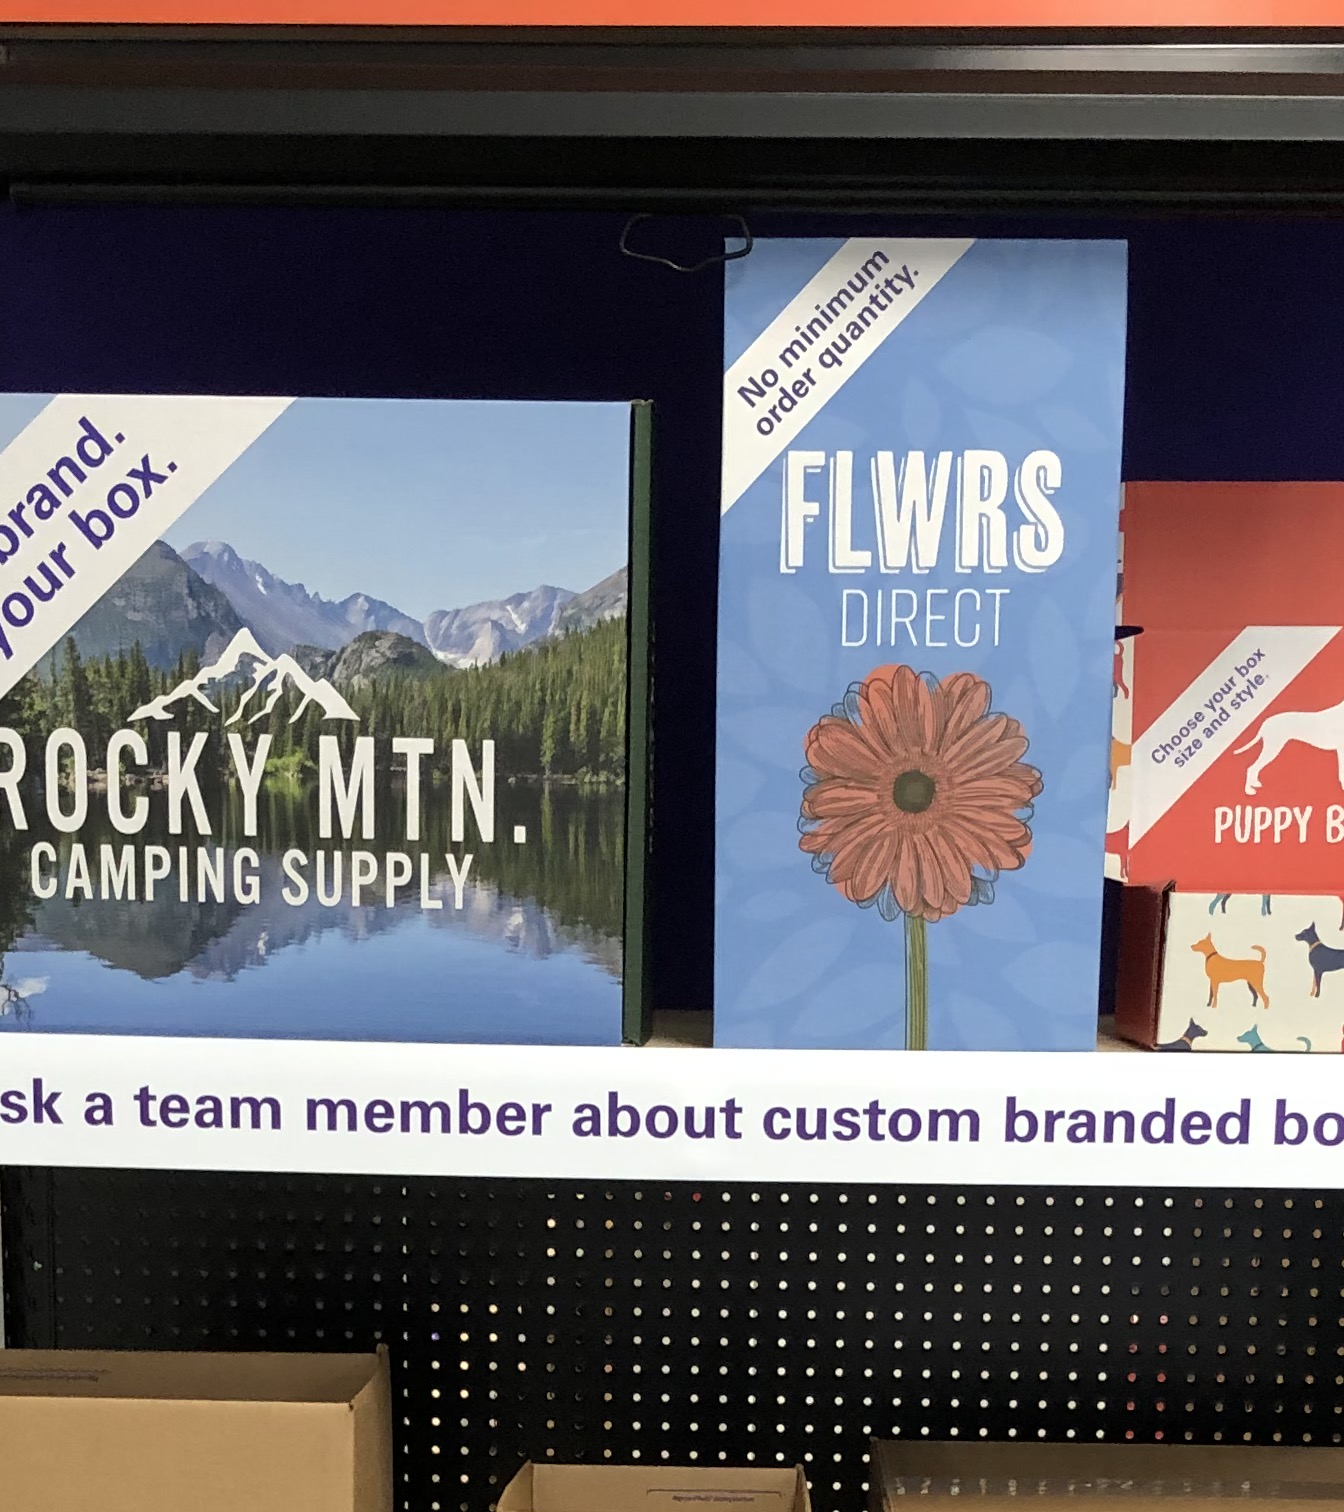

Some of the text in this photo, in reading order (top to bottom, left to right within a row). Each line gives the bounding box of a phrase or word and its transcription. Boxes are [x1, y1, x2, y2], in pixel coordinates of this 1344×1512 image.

[736, 247, 891, 408] No minimum
[755, 262, 920, 437] order quantity.
[68, 452, 180, 551] box.
[779, 449, 1065, 575] FLWRS
[841, 588, 1010, 647] DIRECT
[1150, 648, 1266, 765] Choose your box
[1173, 673, 1270, 768] size and style.
[318, 735, 527, 844] MTN.
[1214, 805, 1312, 844] PUPPY
[29, 841, 474, 910] CAMPING SUPPLY
[83, 1090, 115, 1127] a
[133, 1083, 282, 1131] team
[305, 1088, 553, 1138] member
[571, 1091, 742, 1140] about
[762, 1097, 981, 1144] custom
[1003, 1094, 1251, 1146] branded
